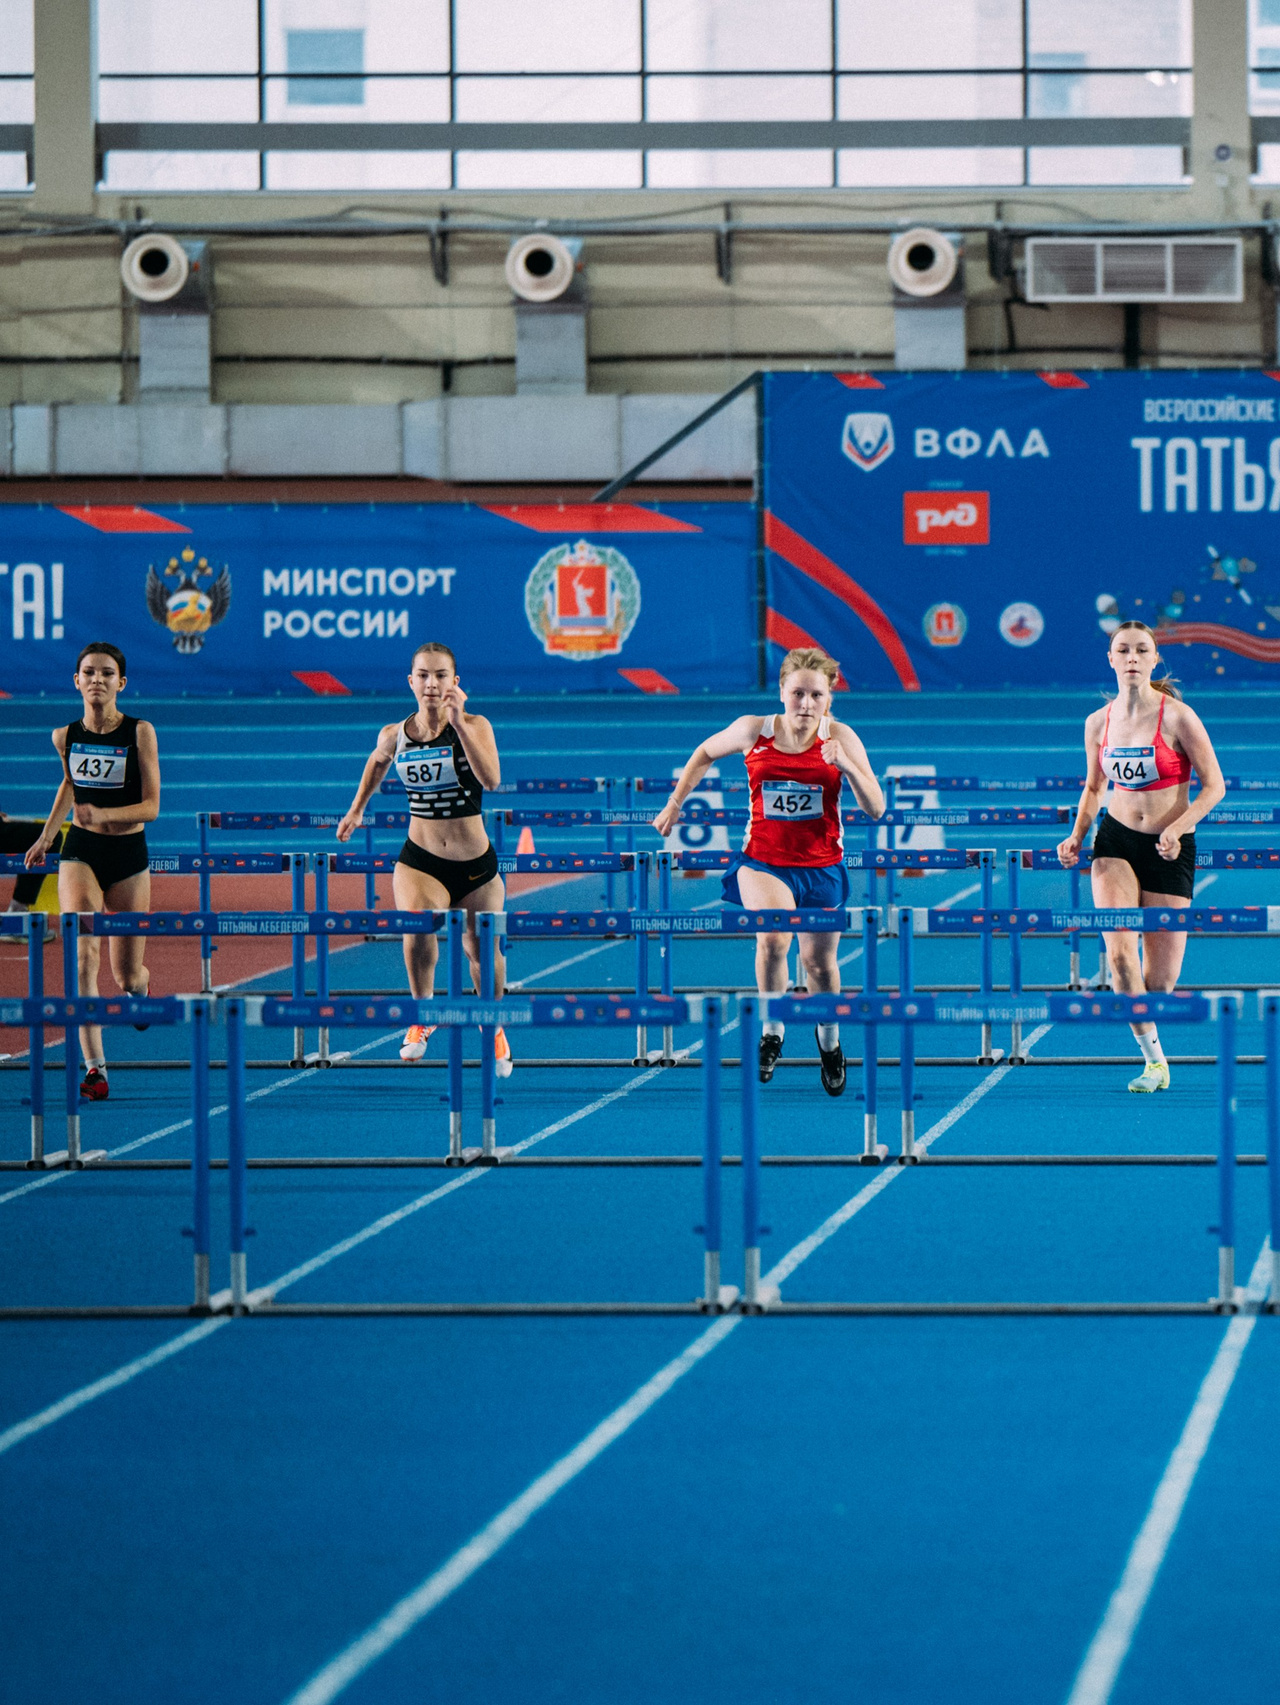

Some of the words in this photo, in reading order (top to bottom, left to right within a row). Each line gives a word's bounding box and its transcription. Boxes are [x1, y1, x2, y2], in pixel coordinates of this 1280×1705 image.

[1143, 395, 1275, 422] ВСЕРОССИЙСКИЕ
[914, 427, 1050, 459] ВФЛА
[263, 567, 456, 597] МИНСПОРТ
[0, 563, 64, 639] А!
[263, 611, 409, 639] РОССИИ
[76, 758, 115, 778] 437
[406, 762, 443, 783] 587
[1112, 761, 1147, 780] 164
[772, 794, 812, 813] 452
[149, 858, 179, 871] ЕДЕВОЙ
[218, 921, 257, 934] ТАТЬЯНЫ
[631, 918, 670, 931] ТАТЬЯНЫ
[1052, 915, 1091, 928] ТАТЬЯНЫ
